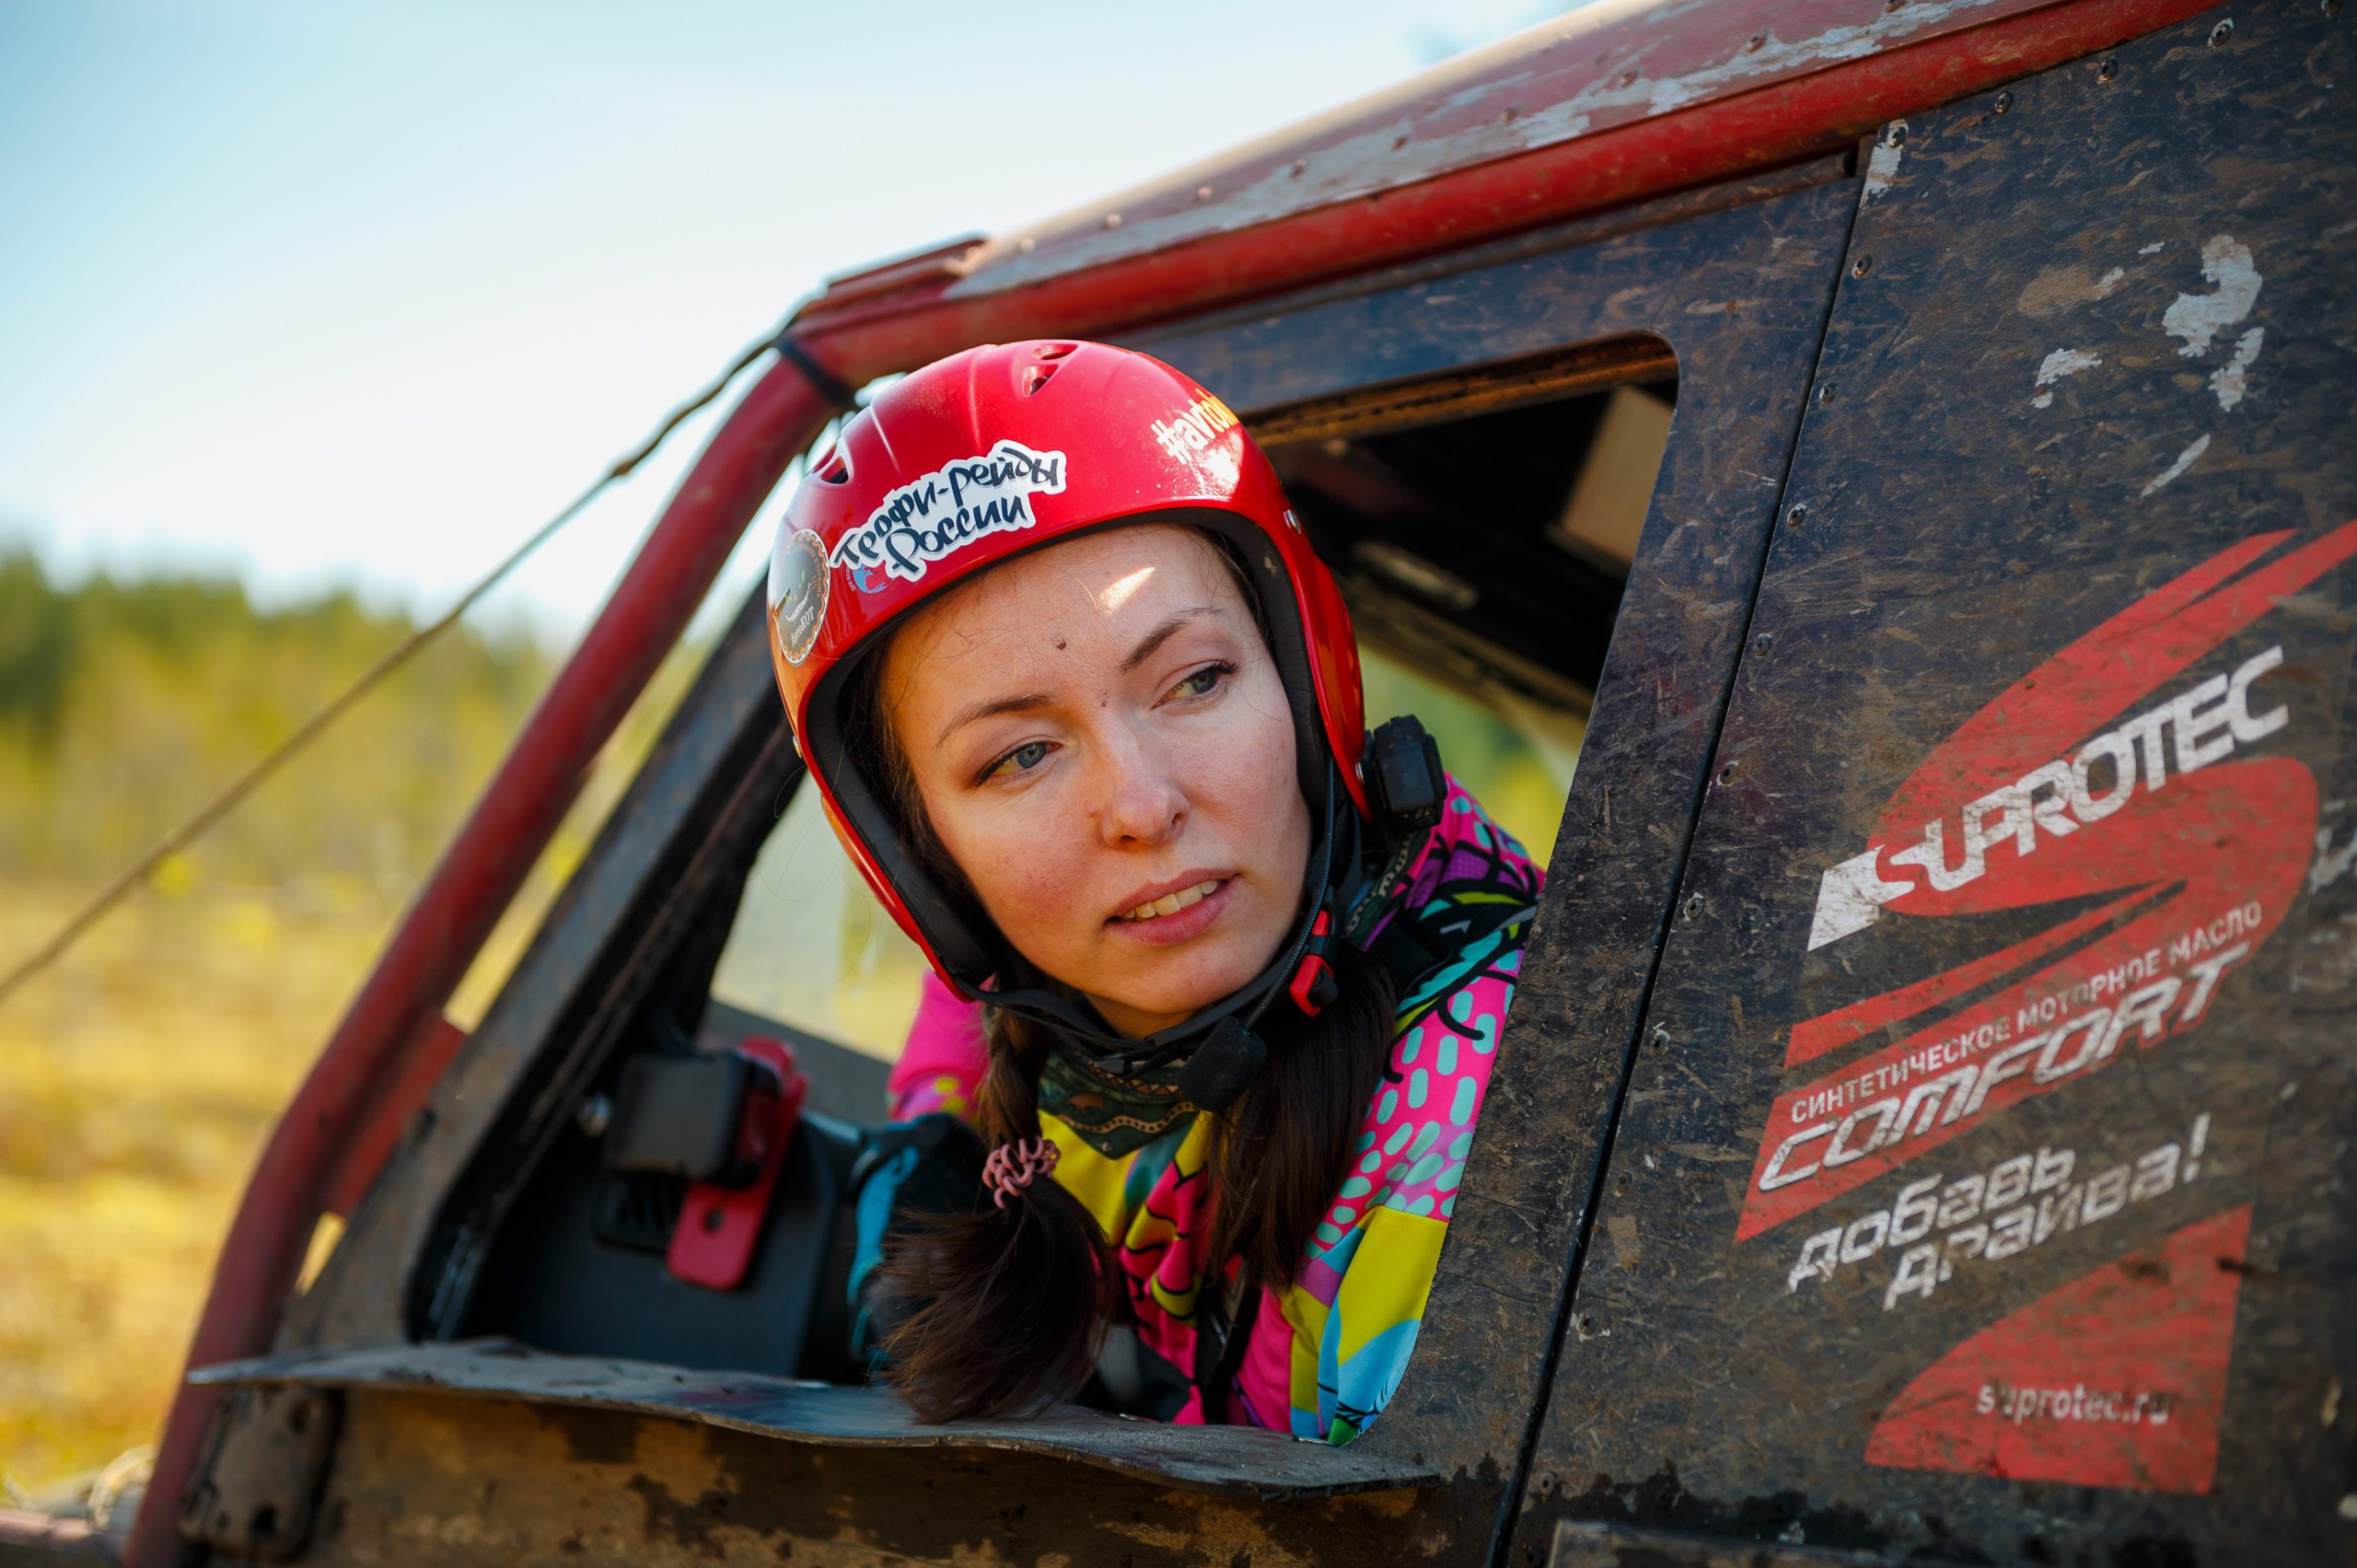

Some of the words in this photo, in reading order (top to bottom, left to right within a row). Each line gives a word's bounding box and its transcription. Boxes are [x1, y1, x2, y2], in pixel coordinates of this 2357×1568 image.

[885, 494, 1028, 574] России
[1807, 645, 2289, 951] SUPROTEC
[1759, 941, 2251, 1191] COMFORT
[1792, 1016, 2012, 1123] СИНТЕТИЧЕСКОЕ
[2017, 948, 2161, 1033] МОТОРНОЕ
[2168, 900, 2262, 966] МАСЛО
